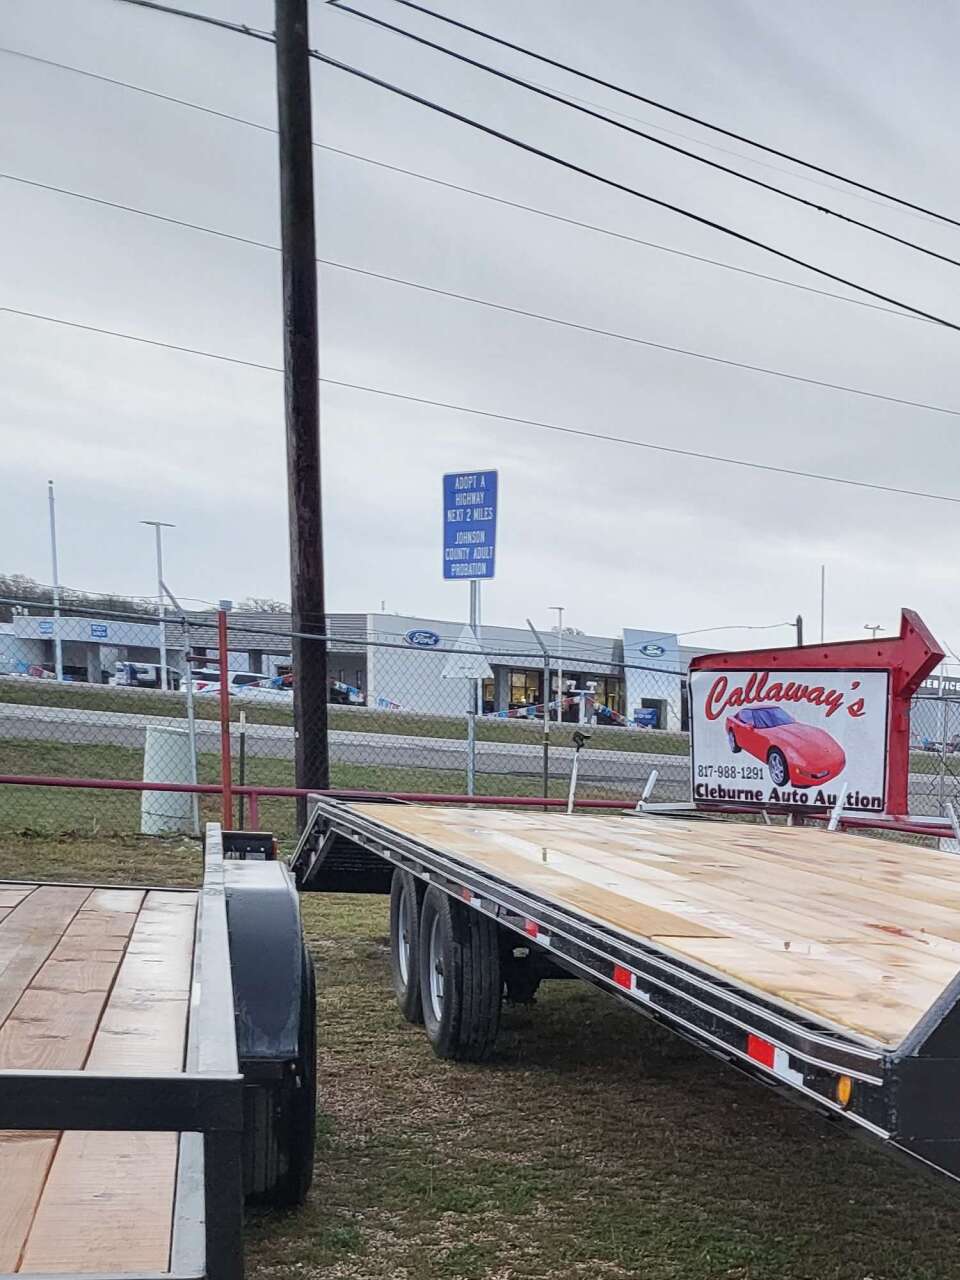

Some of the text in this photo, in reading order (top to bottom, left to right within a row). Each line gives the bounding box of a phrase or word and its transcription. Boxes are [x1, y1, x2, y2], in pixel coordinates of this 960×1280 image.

[455, 475, 486, 489] ADOPT A
[455, 491, 484, 506] HIGHWAY
[447, 507, 494, 522] NEXT 2 MILES
[454, 530, 485, 545] JOHNSON
[445, 546, 494, 561] COUNTY ADULT
[450, 562, 487, 576] PROBATION
[705, 671, 866, 721] Callaway's
[698, 765, 764, 780] 817-988-1291
[695, 783, 882, 808] Cleburne Auto Aution
